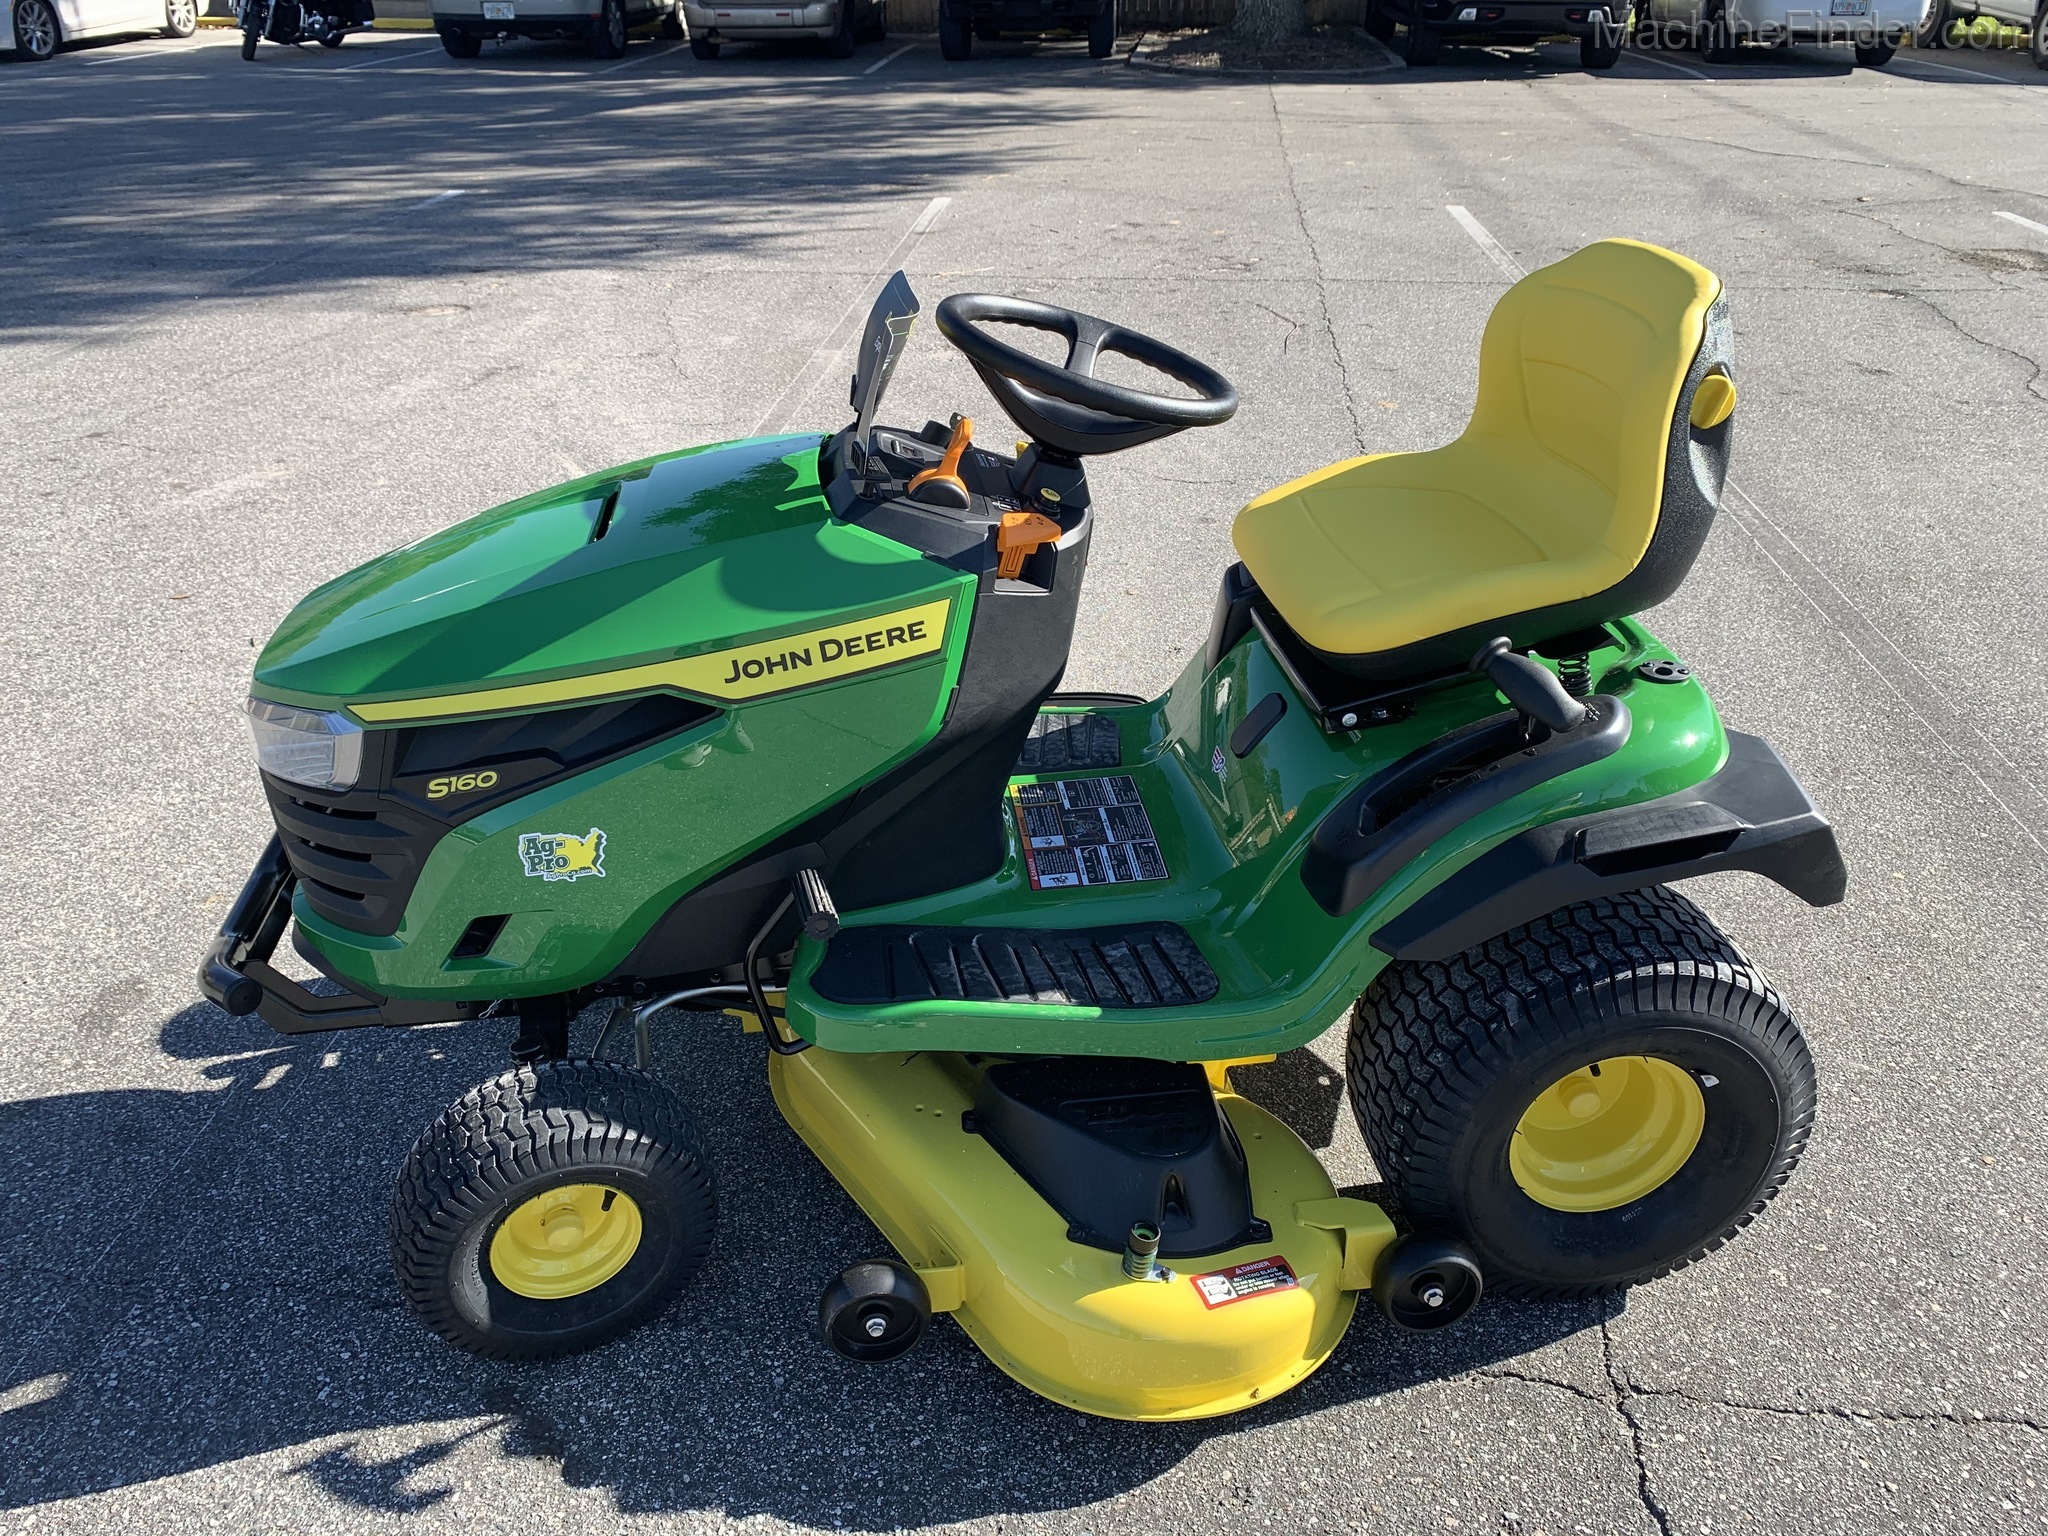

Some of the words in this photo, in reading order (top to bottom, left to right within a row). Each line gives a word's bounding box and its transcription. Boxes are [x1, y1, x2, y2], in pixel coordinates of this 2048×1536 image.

[724, 648, 812, 684] JOHN
[818, 620, 927, 663] DEERE
[427, 771, 498, 799] S160
[525, 837, 563, 857] Ag-
[527, 855, 568, 873] Pro
[1233, 1272, 1260, 1282] ROTATING
[1260, 1267, 1278, 1276] BLADE
[1240, 1261, 1270, 1273] DANGER
